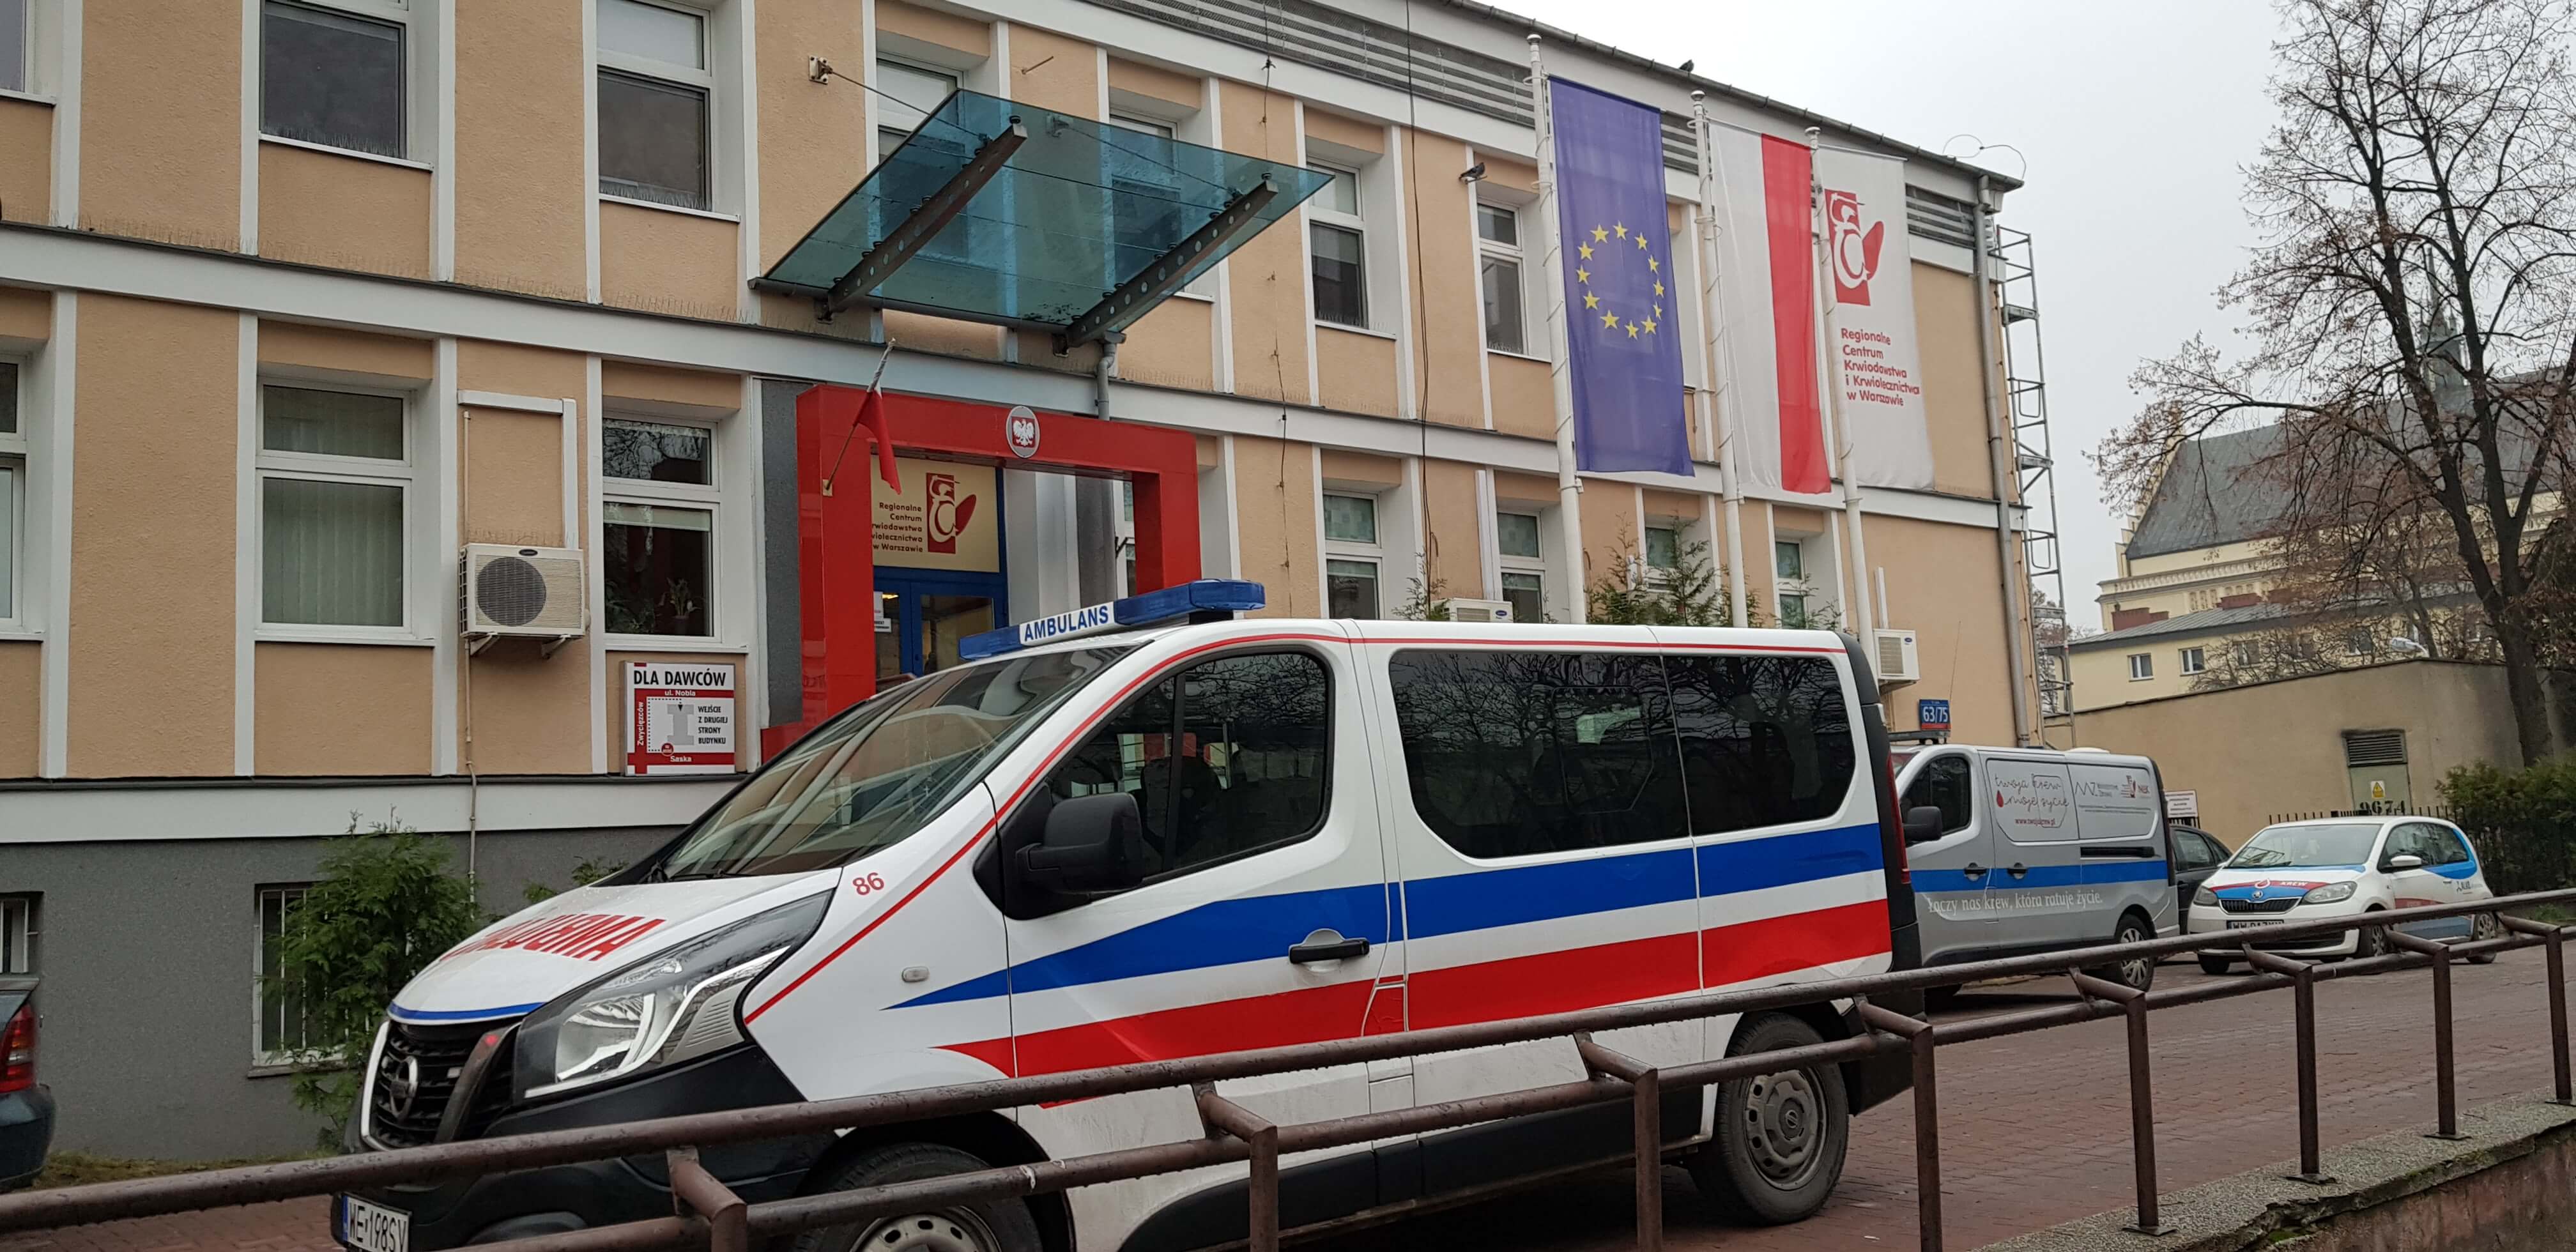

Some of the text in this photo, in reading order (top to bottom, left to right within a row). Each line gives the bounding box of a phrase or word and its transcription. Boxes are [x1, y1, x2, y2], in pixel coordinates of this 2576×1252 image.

[1841, 328, 1891, 346] Regionalne
[1843, 344, 1884, 359] Centrum
[1844, 360, 1907, 378] Krwiodawstwa
[1845, 374, 1920, 395] i Krwiolecznictwa
[1846, 390, 1904, 406] w Warszawie
[879, 502, 922, 512] Regionalne
[890, 513, 923, 522] Centrum
[872, 523, 923, 532] rwiodawstwa
[882, 543, 923, 553] Warszawie
[1024, 606, 1109, 642] AMBULANS
[634, 668, 726, 687] DLA DAWCÓW
[698, 705, 721, 714] WEJŚCIE
[1923, 706, 1948, 723] 63/75
[852, 872, 885, 896] 86
[1961, 898, 1981, 910] nas
[2015, 891, 2043, 908] która
[2044, 890, 2074, 910] ratuje
